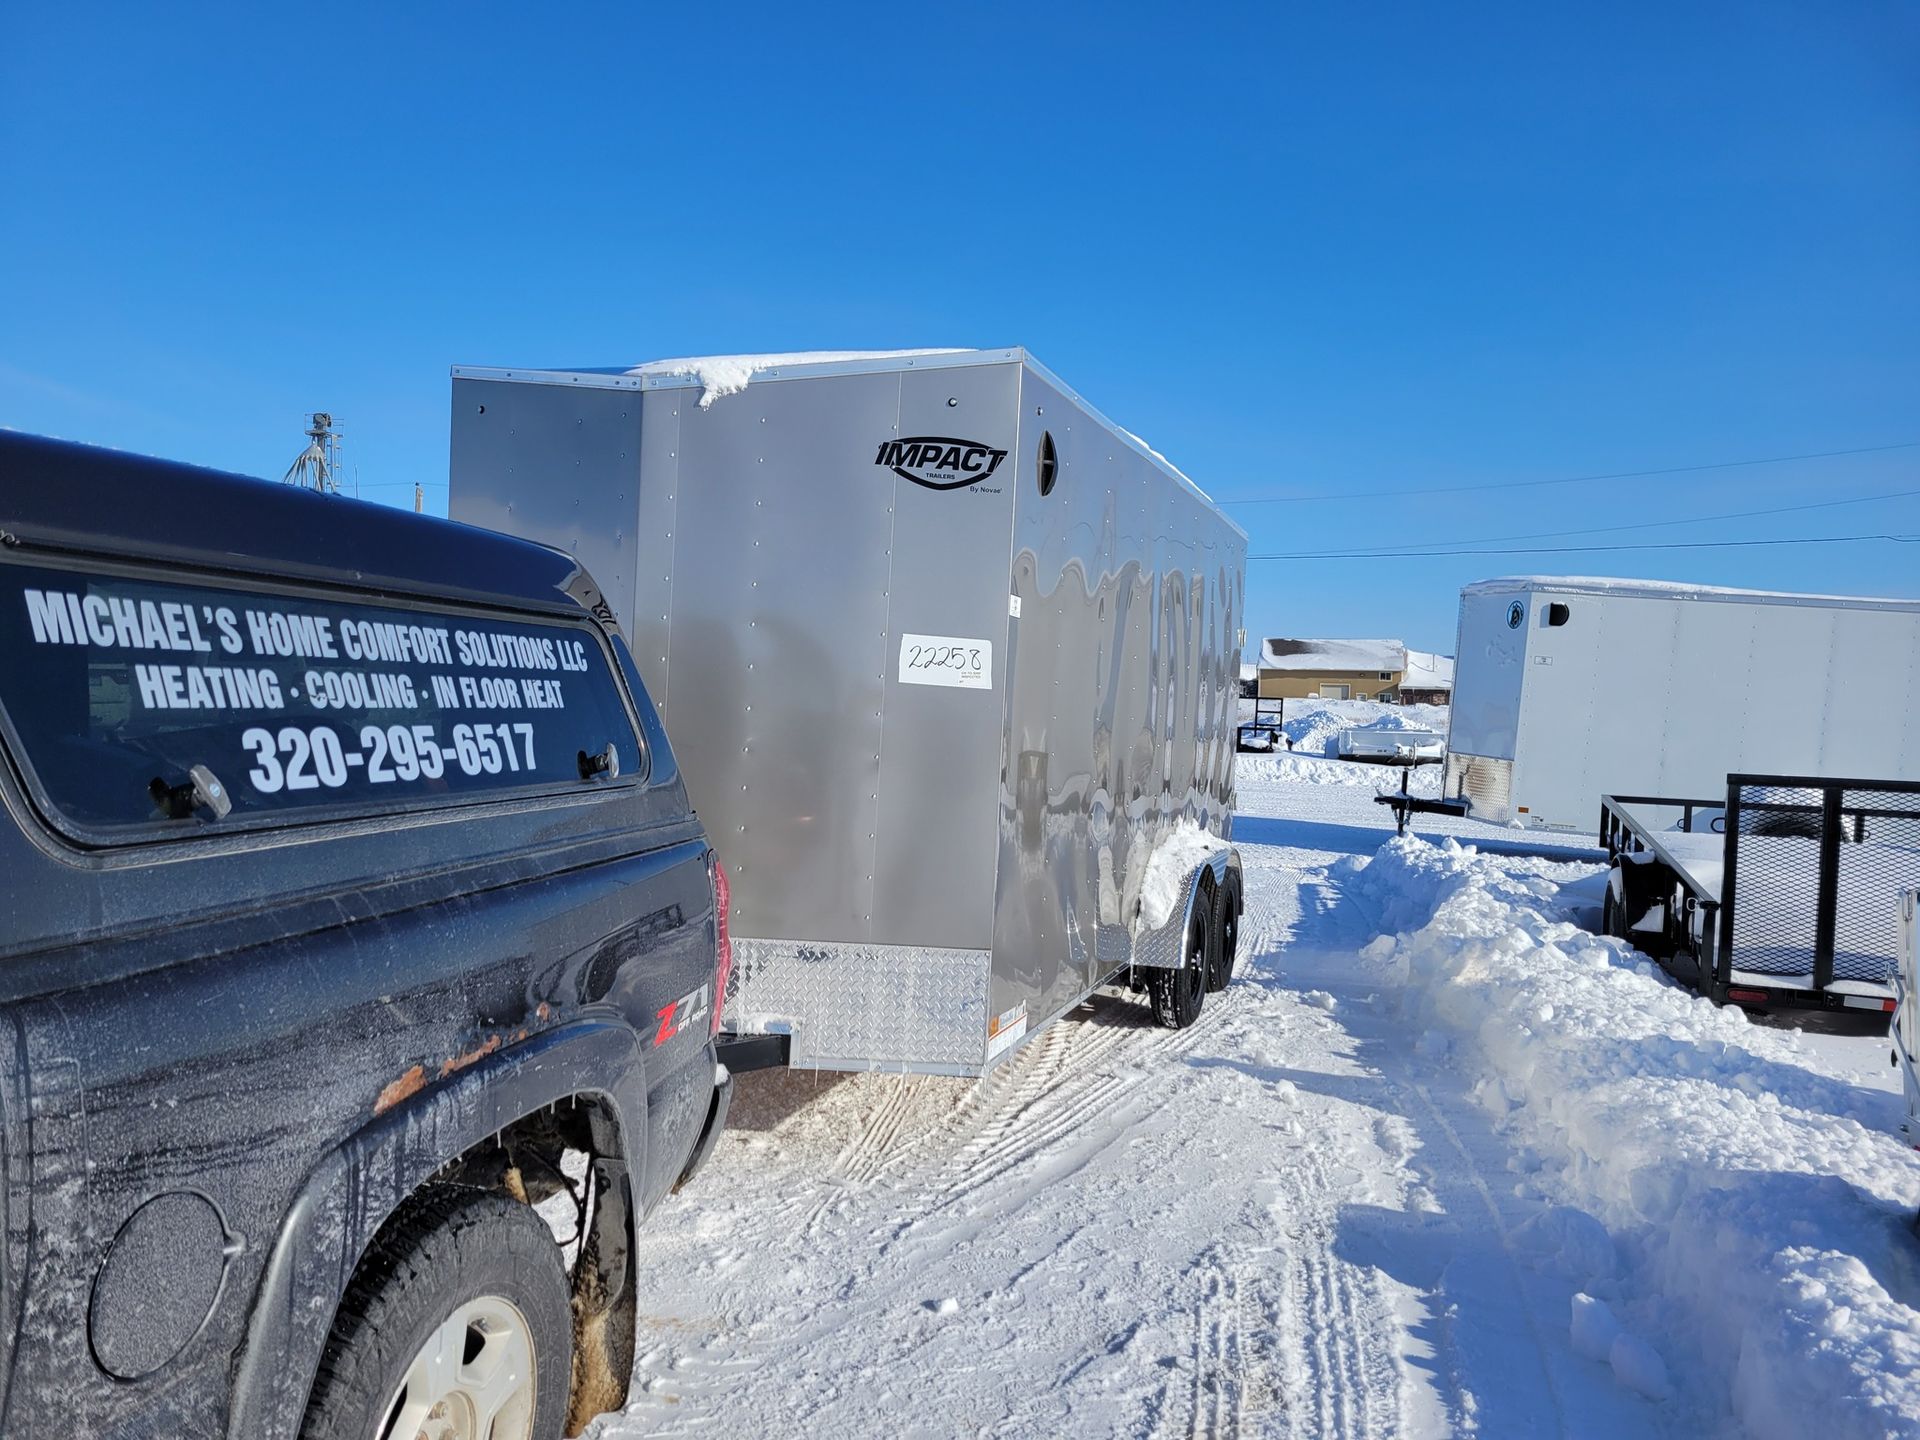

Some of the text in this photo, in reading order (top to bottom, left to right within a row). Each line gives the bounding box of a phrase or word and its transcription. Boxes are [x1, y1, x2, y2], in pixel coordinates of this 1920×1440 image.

[875, 441, 1008, 473] IMPACT
[926, 472, 955, 480] TRAILERS
[969, 485, 979, 494] By
[24, 590, 589, 671] MICHAEL'S HOME COMFORT SOLUTIONS LLC
[908, 645, 981, 671] 22258
[135, 665, 565, 709] HEATING COOLING IN FLOOR HEAT
[242, 723, 537, 793] 320-295-6517
[654, 983, 708, 1049] Z71
